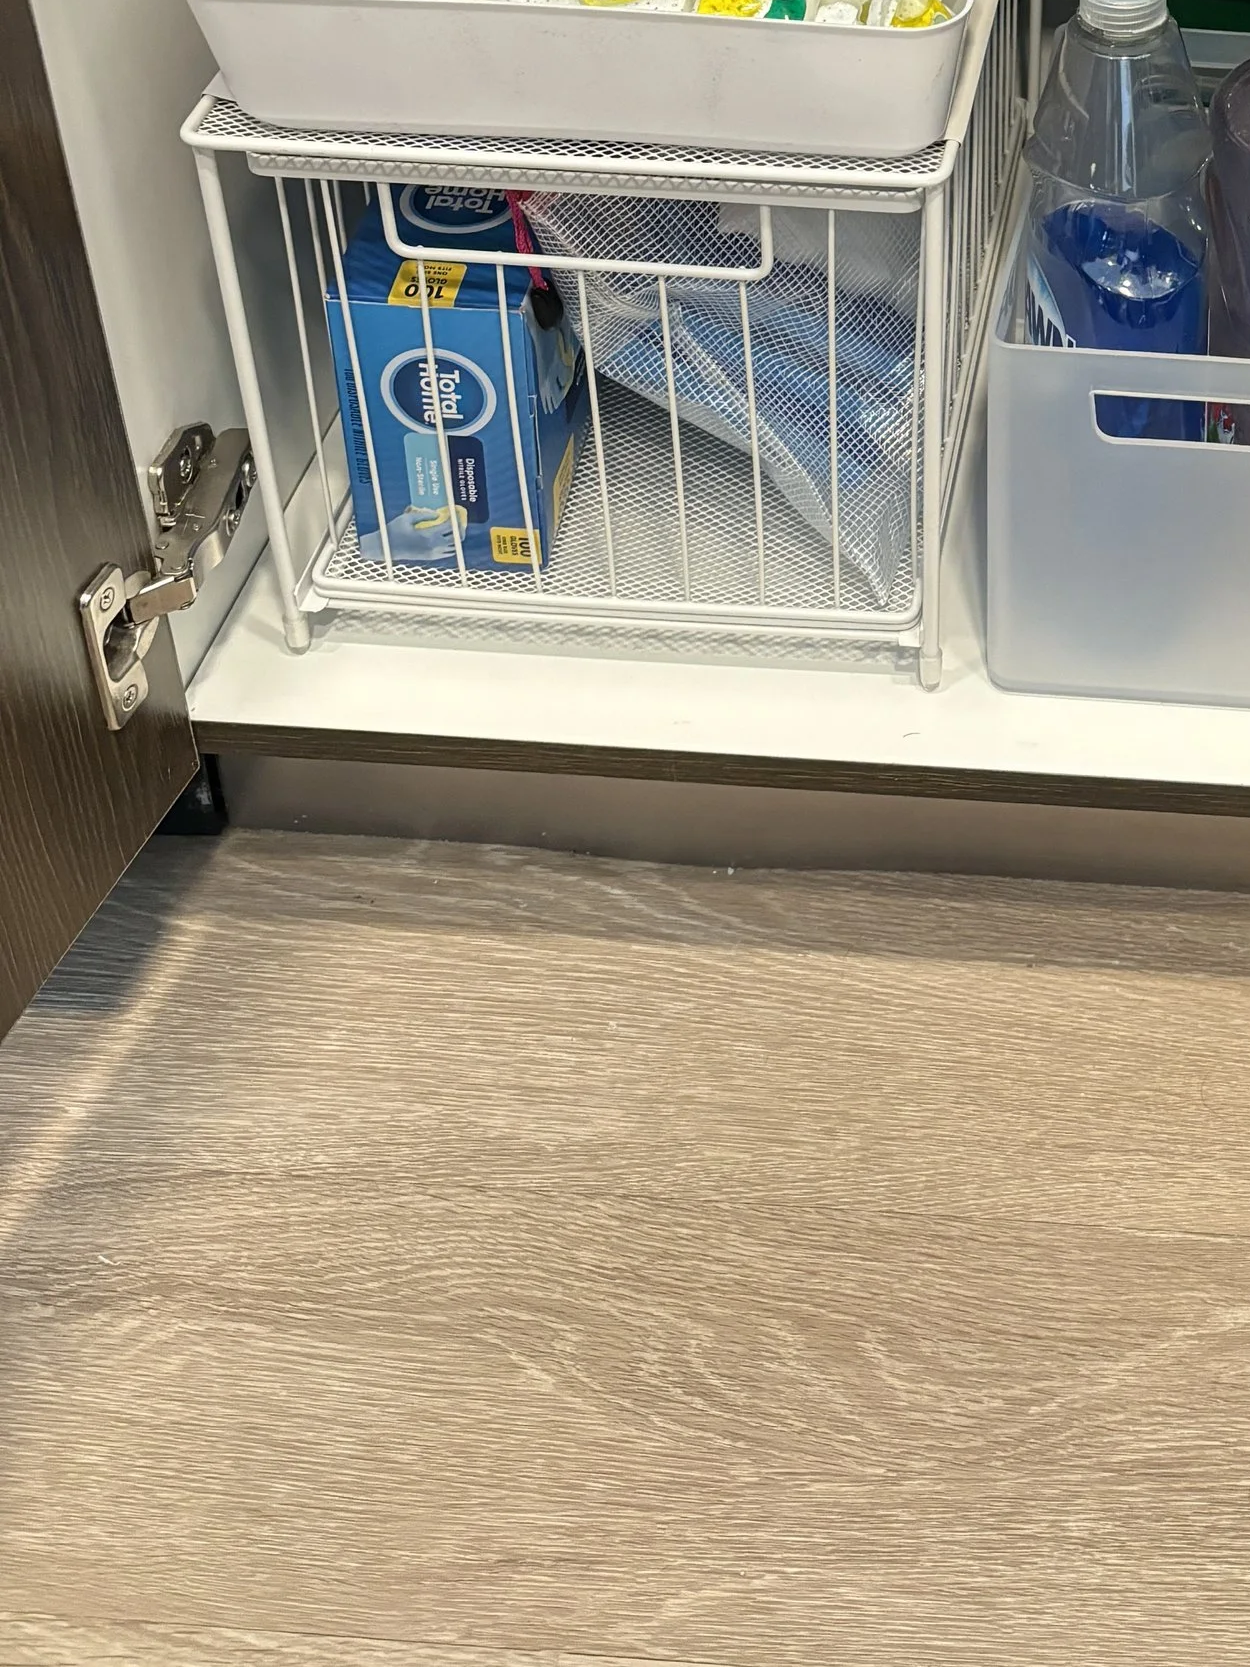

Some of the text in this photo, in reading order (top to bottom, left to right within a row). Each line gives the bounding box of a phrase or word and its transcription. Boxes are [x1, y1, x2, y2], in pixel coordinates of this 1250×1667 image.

[425, 185, 507, 202] Home
[424, 195, 494, 214] Total
[410, 276, 447, 286] GLOS
[439, 369, 465, 420] Total
[465, 458, 477, 503] Disposable
